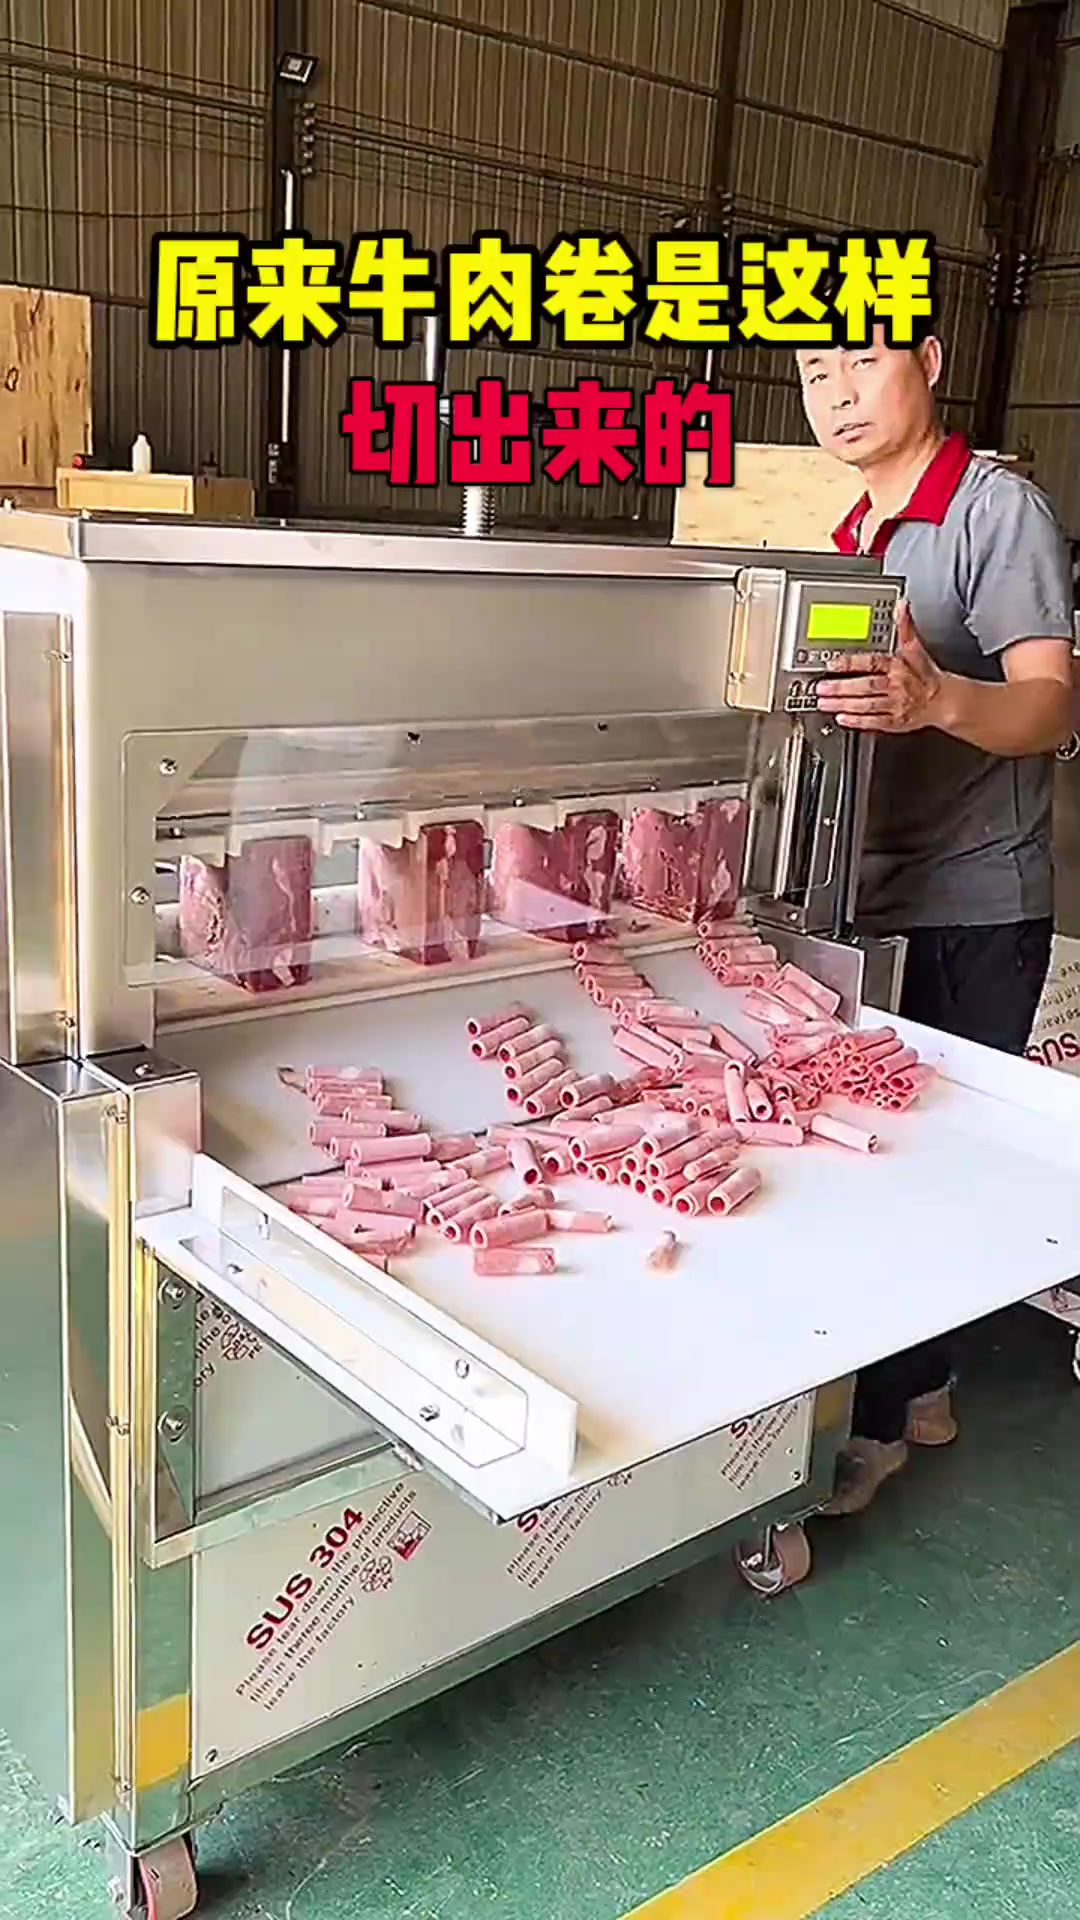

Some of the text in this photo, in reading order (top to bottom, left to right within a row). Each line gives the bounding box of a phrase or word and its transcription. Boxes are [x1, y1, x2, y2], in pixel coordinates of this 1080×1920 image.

[235, 1482, 404, 1695] Please tear down the protective
[247, 1508, 363, 1649] SUS 304
[250, 1678, 274, 1703] film
[272, 1661, 286, 1676] in
[264, 1596, 355, 1710] leave the factory
